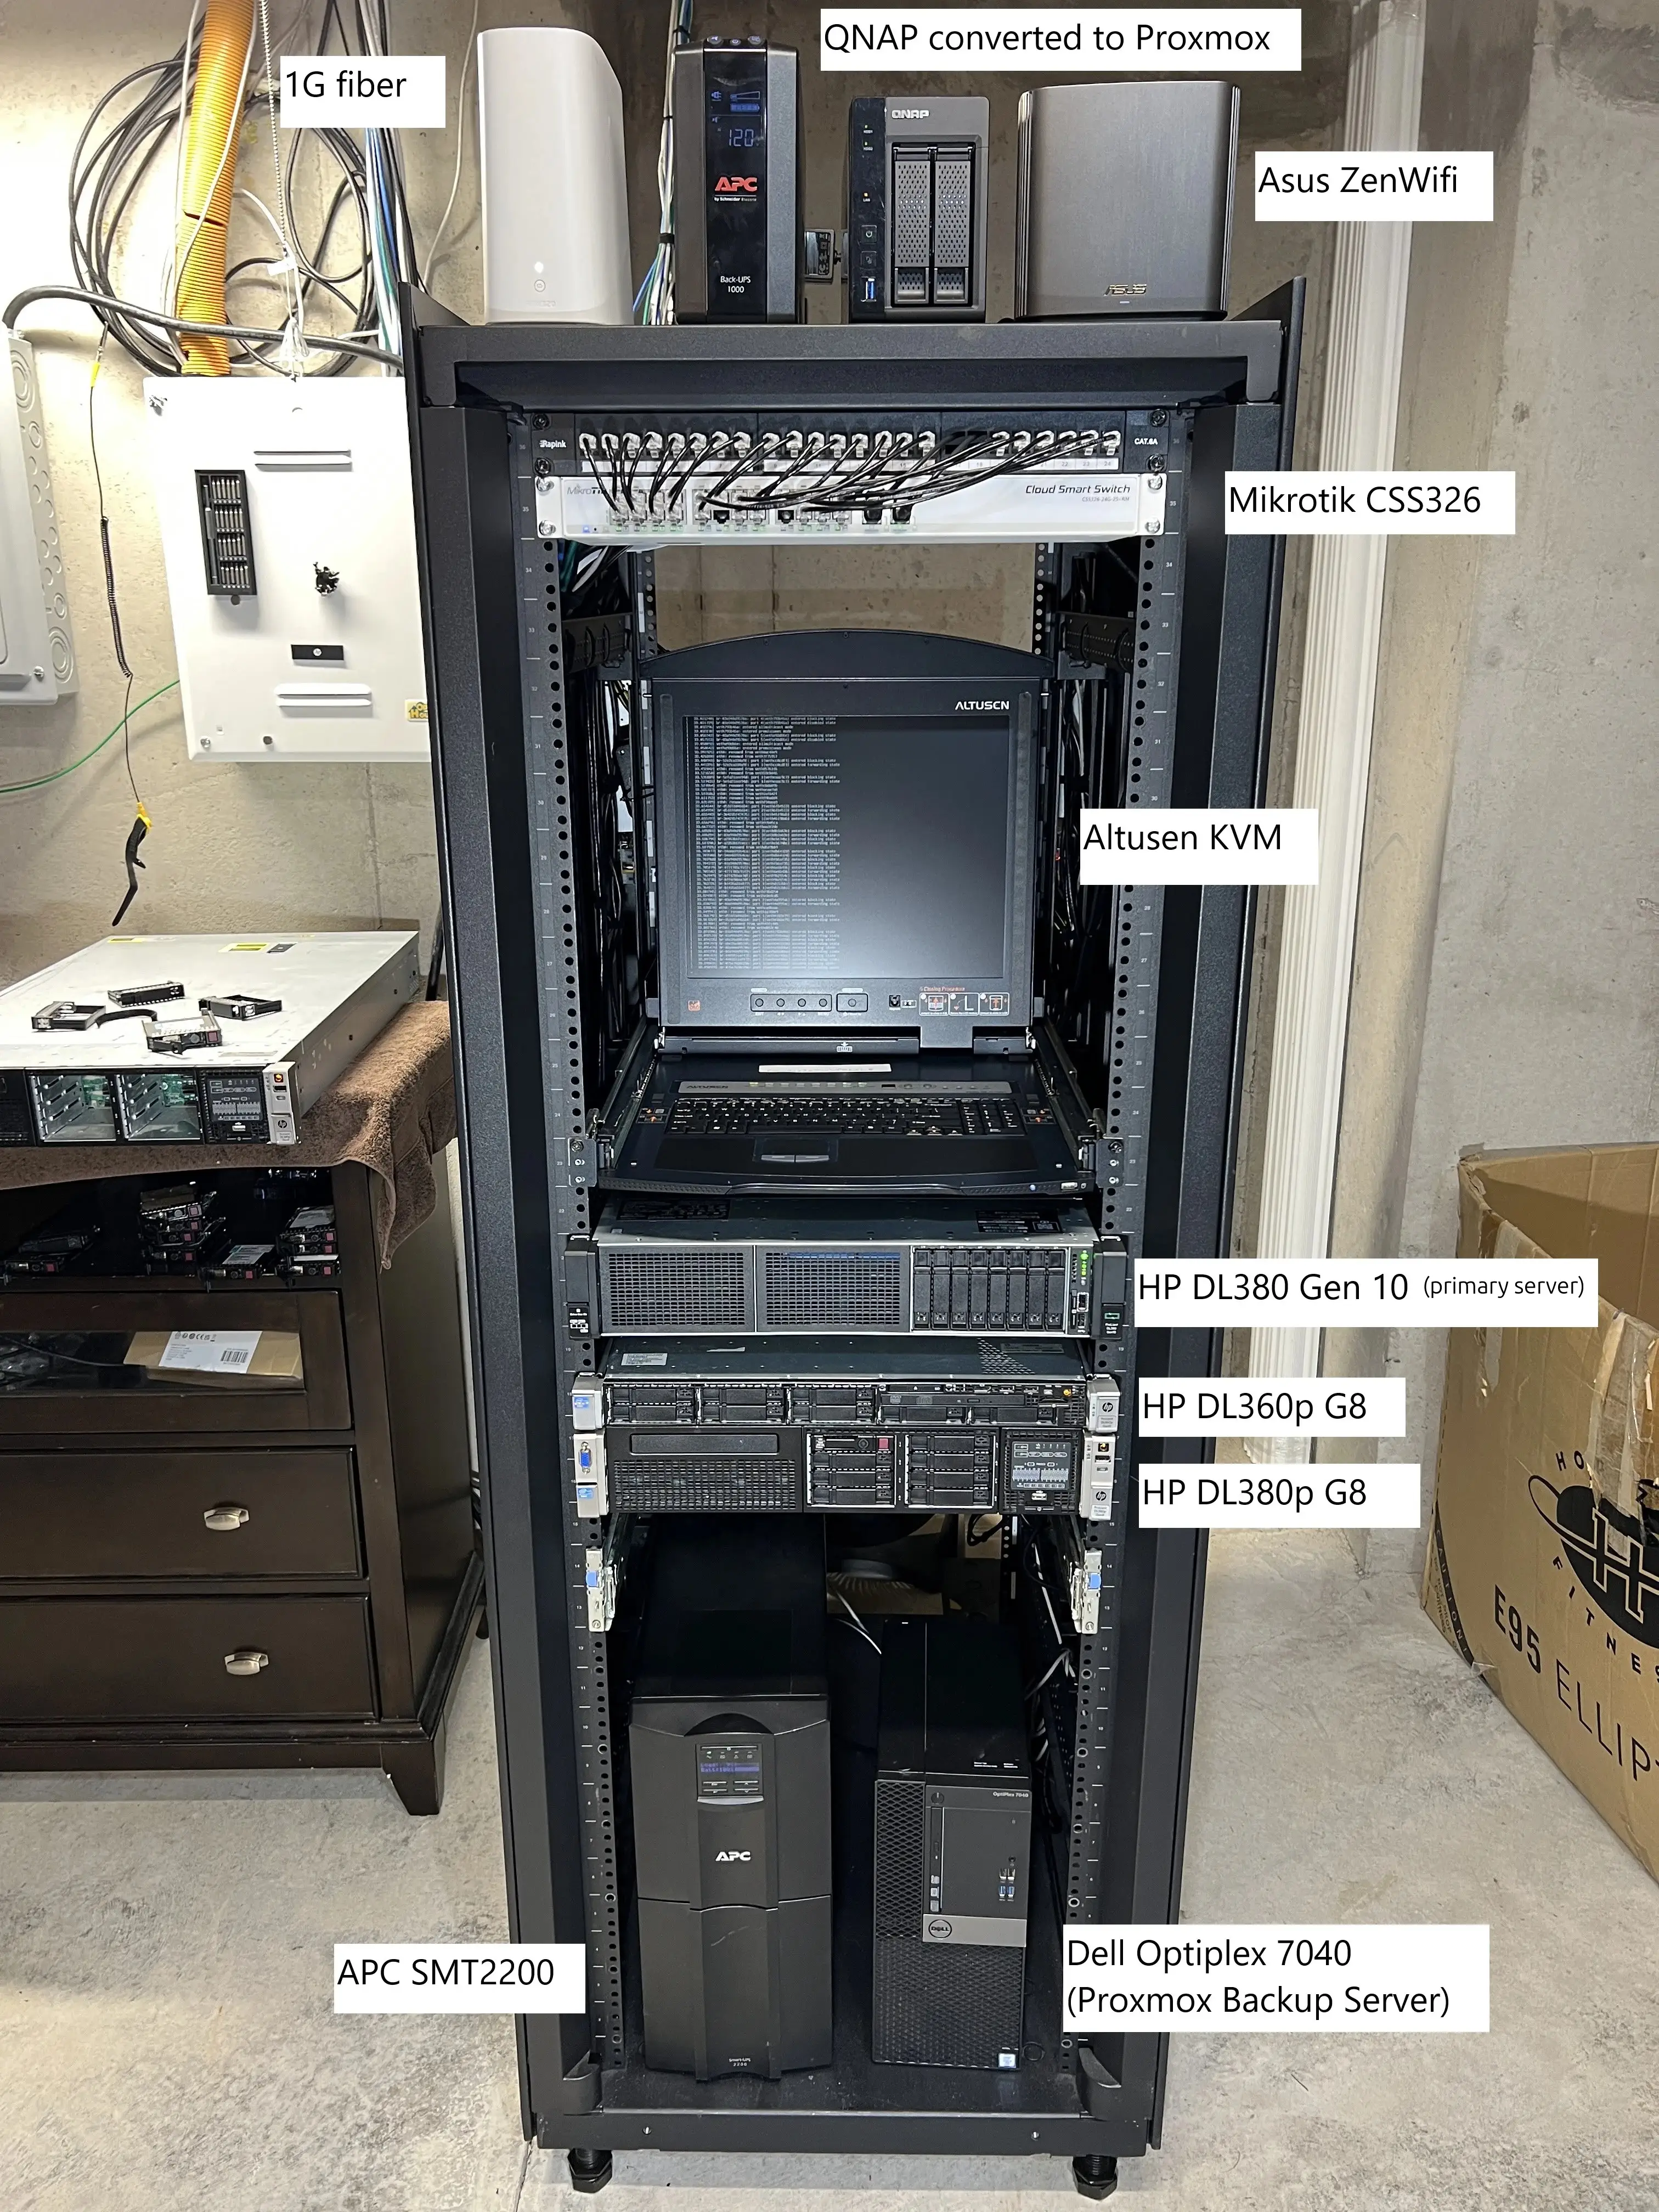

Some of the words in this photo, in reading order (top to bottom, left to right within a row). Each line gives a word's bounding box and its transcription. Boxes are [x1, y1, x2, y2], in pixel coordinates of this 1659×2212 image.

[891, 110, 929, 119] QNAP
[729, 129, 754, 147] 120
[714, 177, 758, 192] APC
[1103, 283, 1147, 296] ASUS
[1025, 485, 1056, 494] Cloud
[1058, 485, 1091, 494] Smart
[1094, 484, 1130, 493] Switch
[1495, 1584, 1541, 1674] E95
[1556, 1658, 1659, 1782] ELLIP
[715, 1850, 751, 1862] APC
